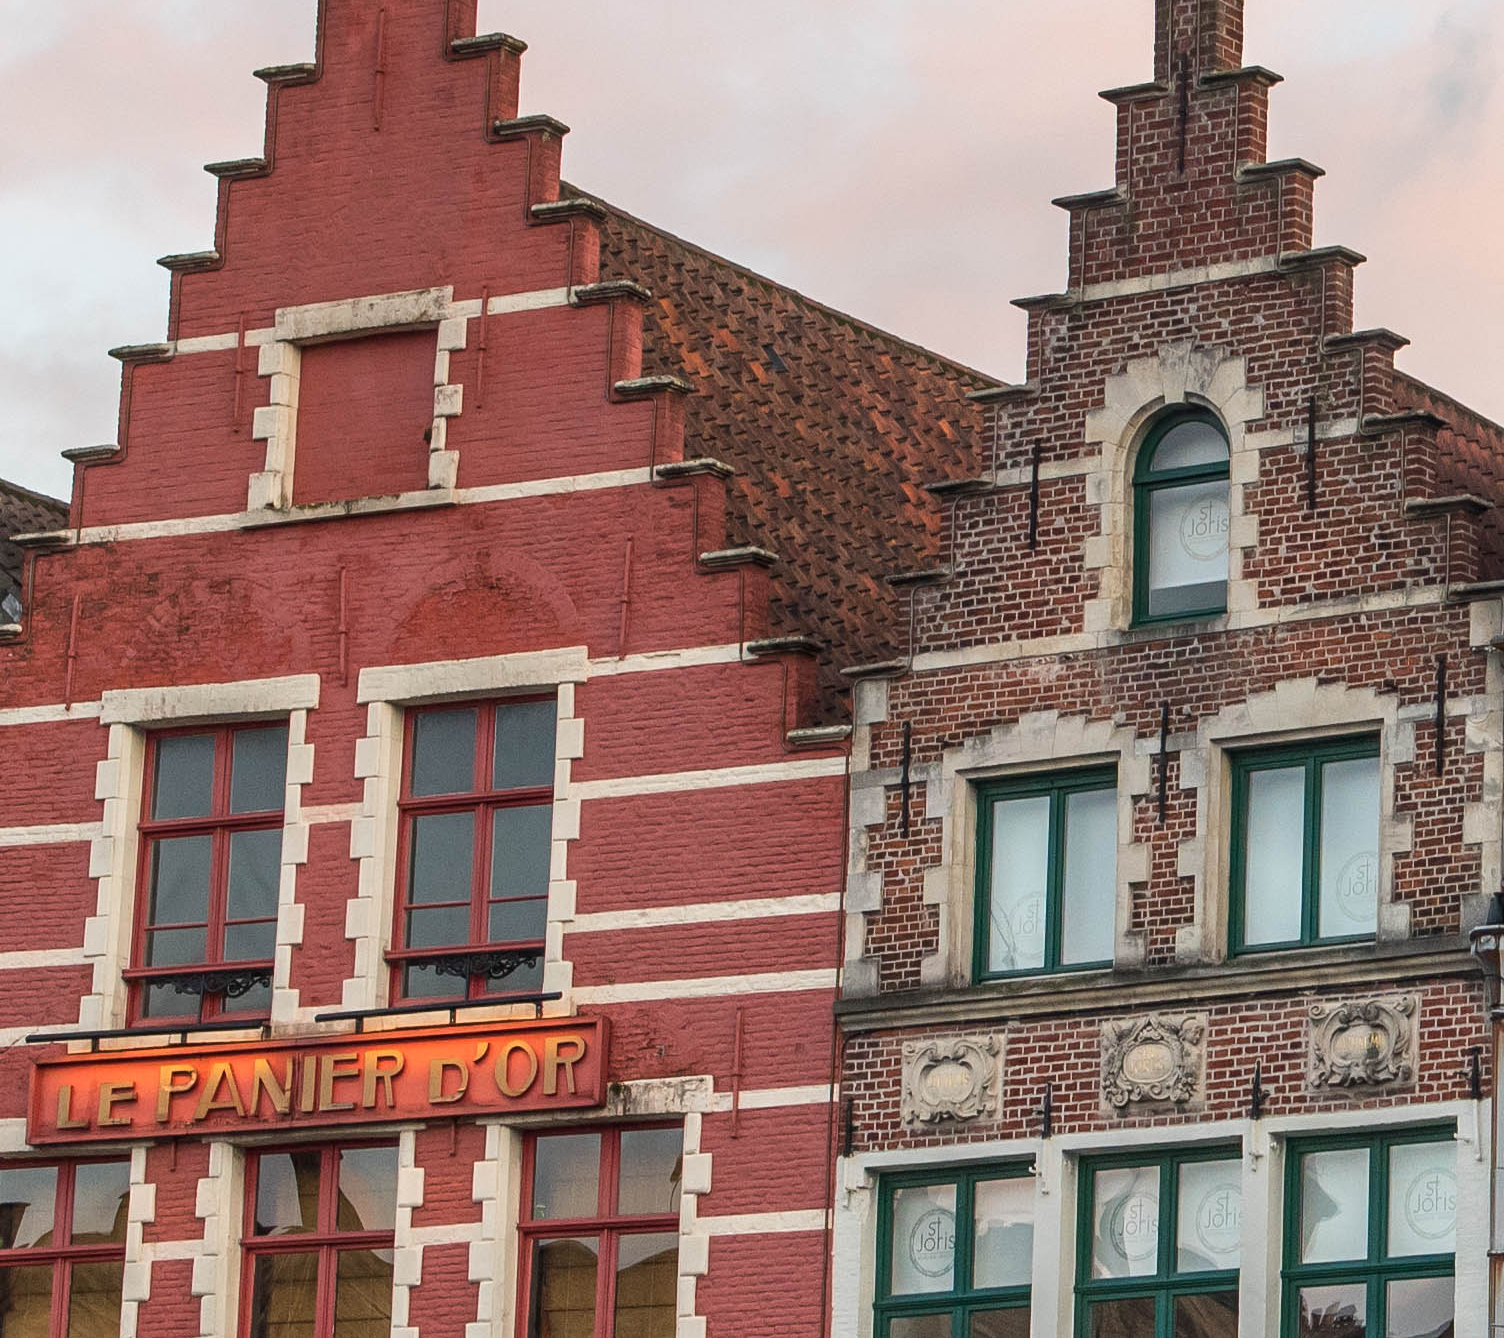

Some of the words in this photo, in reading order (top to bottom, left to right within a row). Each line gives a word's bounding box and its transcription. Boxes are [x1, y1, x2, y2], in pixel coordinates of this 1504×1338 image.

[56, 1081, 137, 1130] LE
[154, 1048, 406, 1124] PANIER
[428, 1034, 587, 1105] D'OR
